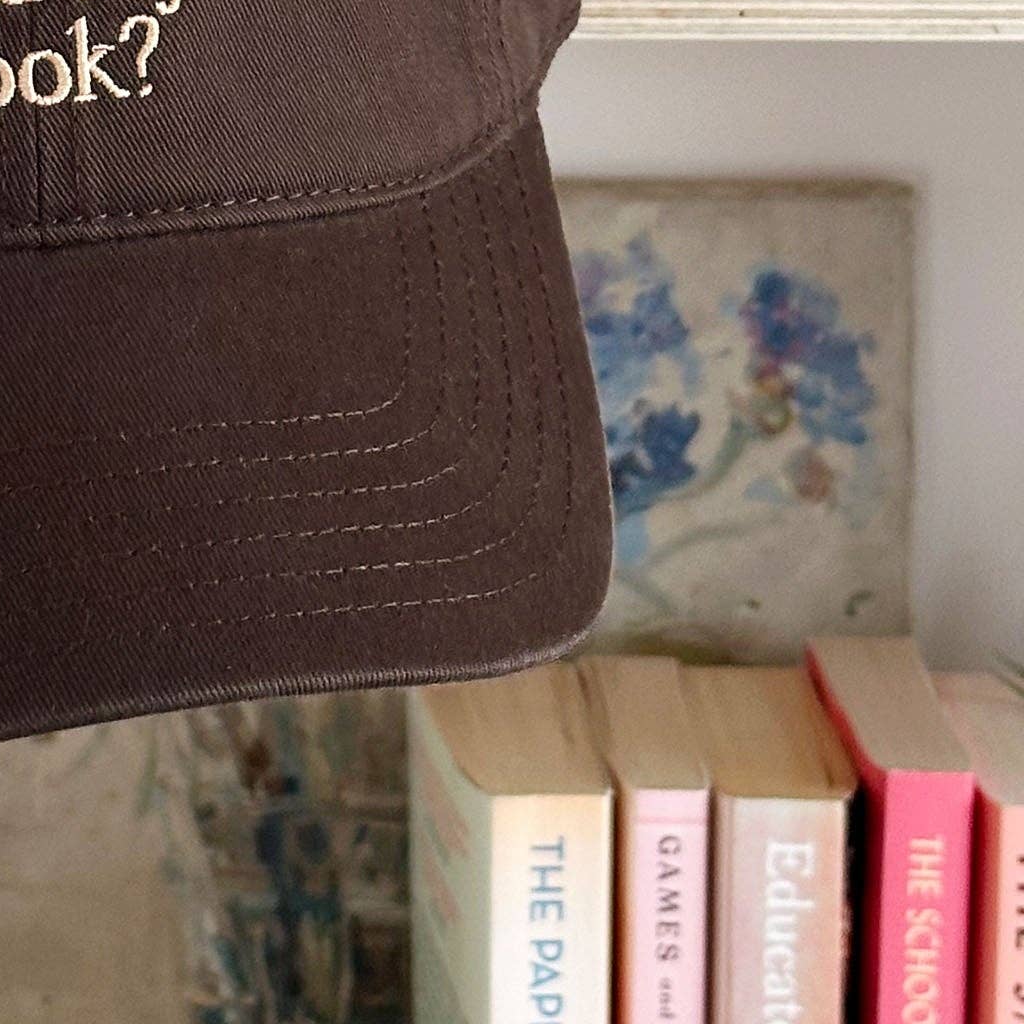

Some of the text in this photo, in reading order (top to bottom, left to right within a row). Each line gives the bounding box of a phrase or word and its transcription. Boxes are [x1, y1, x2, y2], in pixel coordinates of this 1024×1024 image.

[528, 835, 565, 1024] THE PAP
[654, 835, 682, 961] GAMES
[762, 842, 814, 1024] Educat
[906, 837, 946, 896] THE
